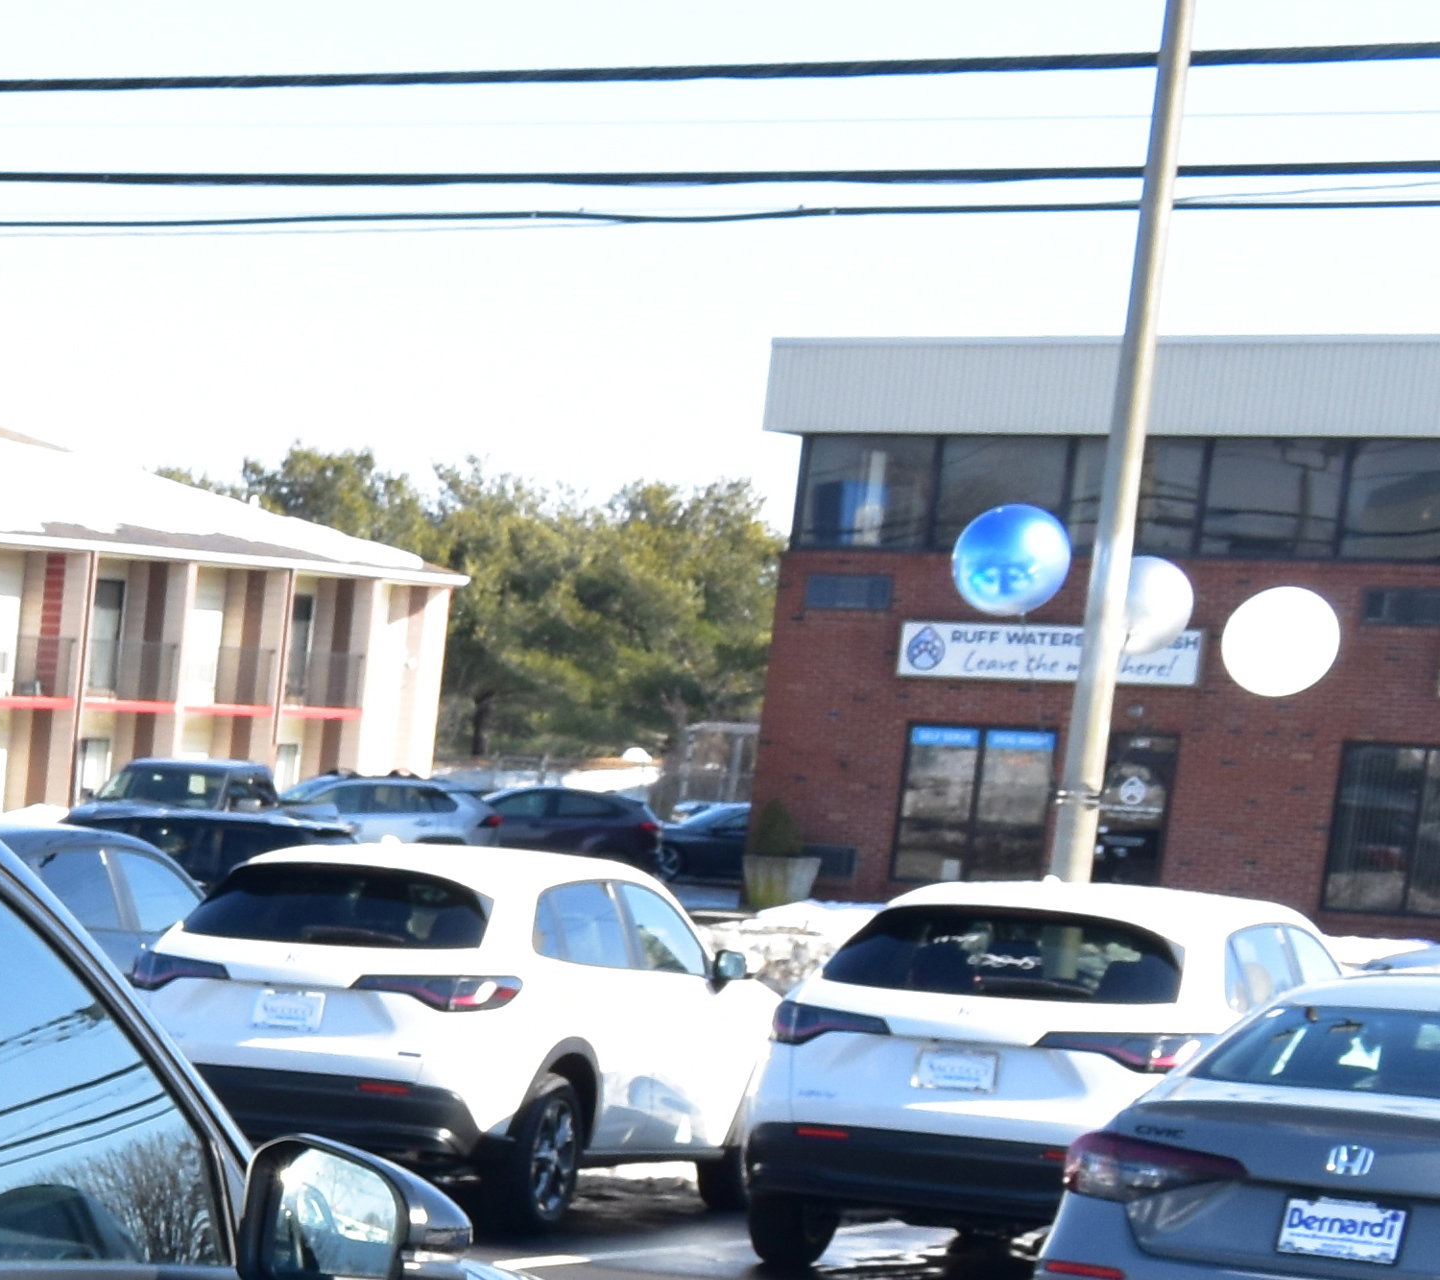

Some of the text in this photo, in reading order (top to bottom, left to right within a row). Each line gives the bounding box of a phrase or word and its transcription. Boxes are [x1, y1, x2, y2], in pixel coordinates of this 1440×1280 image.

[951, 630, 999, 643] RUFF
[963, 649, 1018, 673] Leave
[1287, 1207, 1400, 1241] Bernardi
